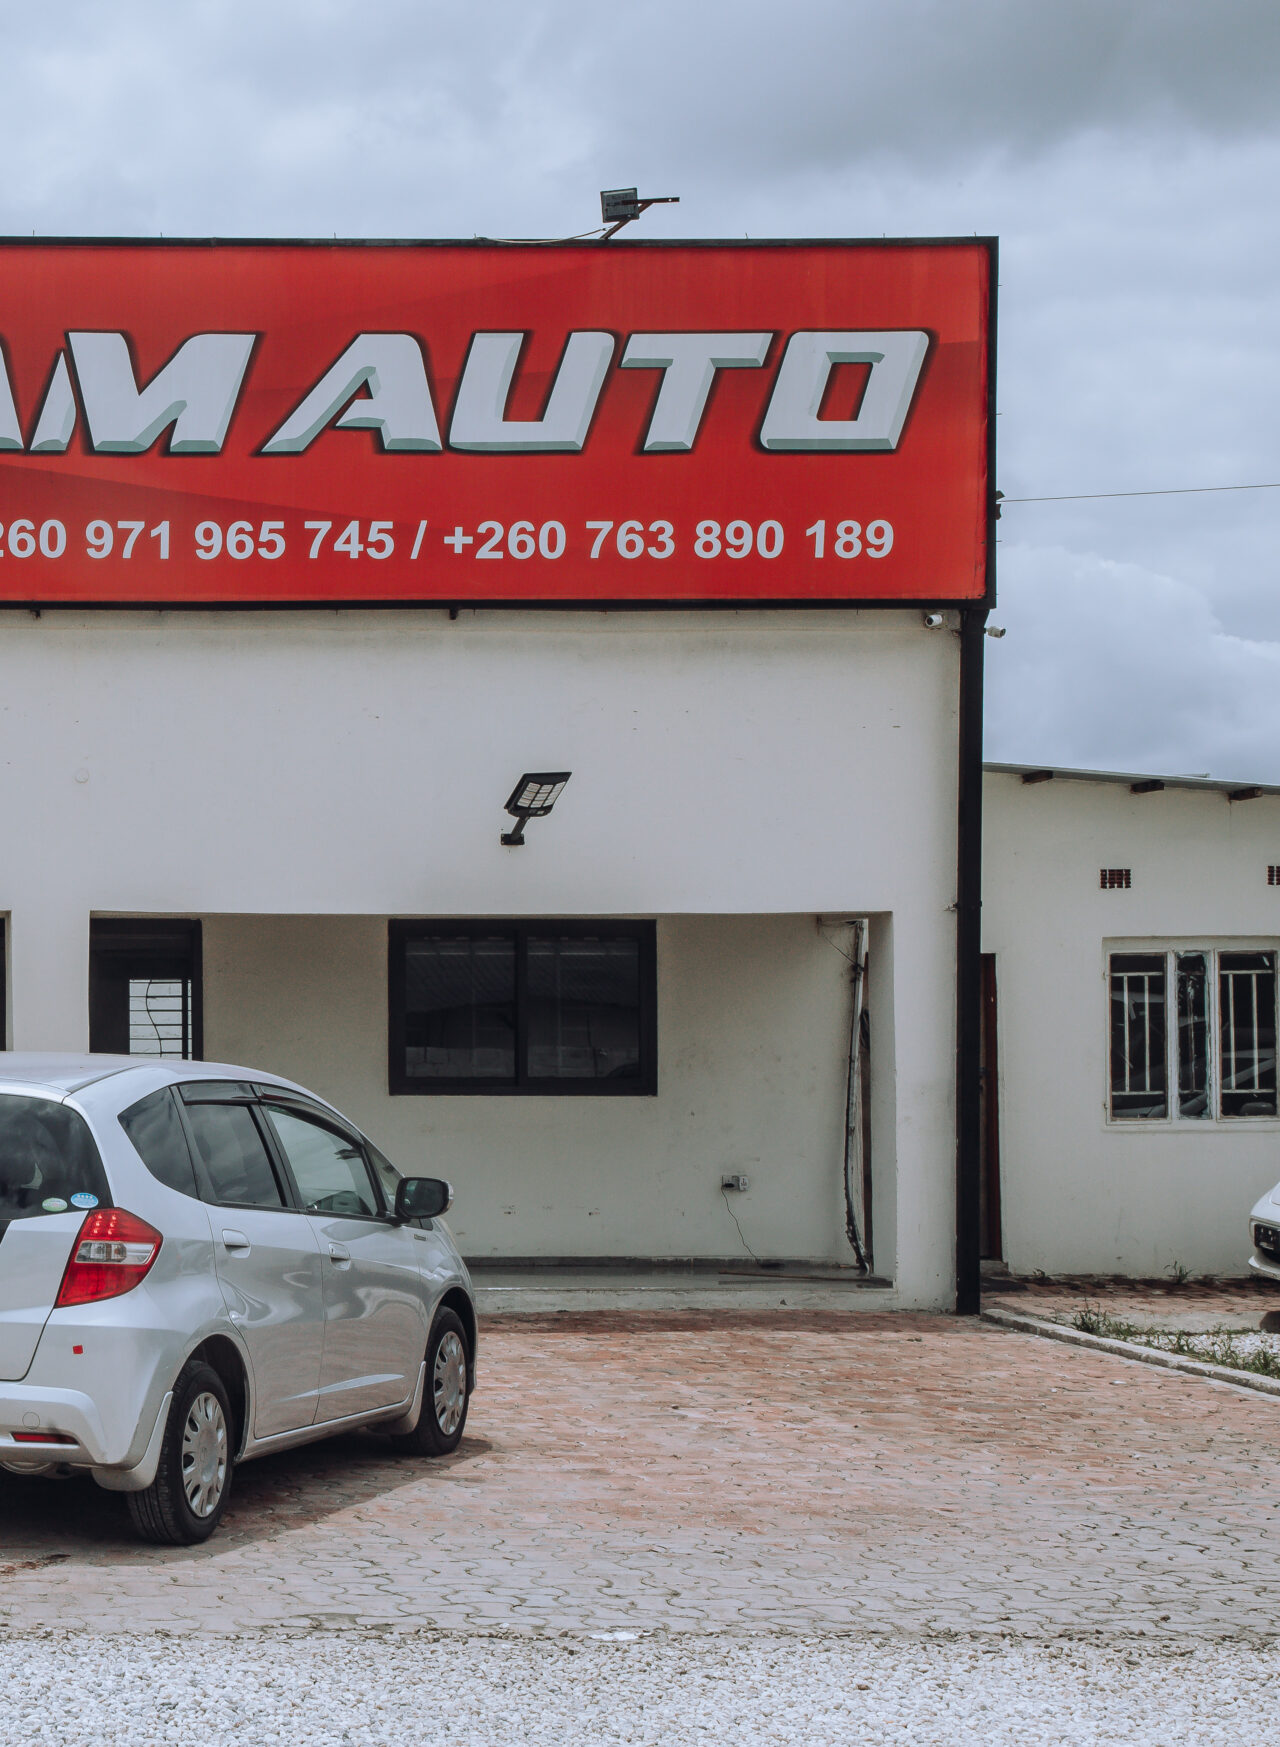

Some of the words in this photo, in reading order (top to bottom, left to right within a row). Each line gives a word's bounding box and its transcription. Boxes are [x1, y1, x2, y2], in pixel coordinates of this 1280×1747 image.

[260, 330, 930, 453] AUTO
[85, 519, 170, 560] 971
[194, 520, 286, 561] 965
[304, 520, 395, 560] 745
[410, 519, 428, 560] /
[443, 520, 567, 560] +260
[585, 519, 676, 559] 763
[693, 519, 785, 559] 890
[805, 519, 894, 559] 189
